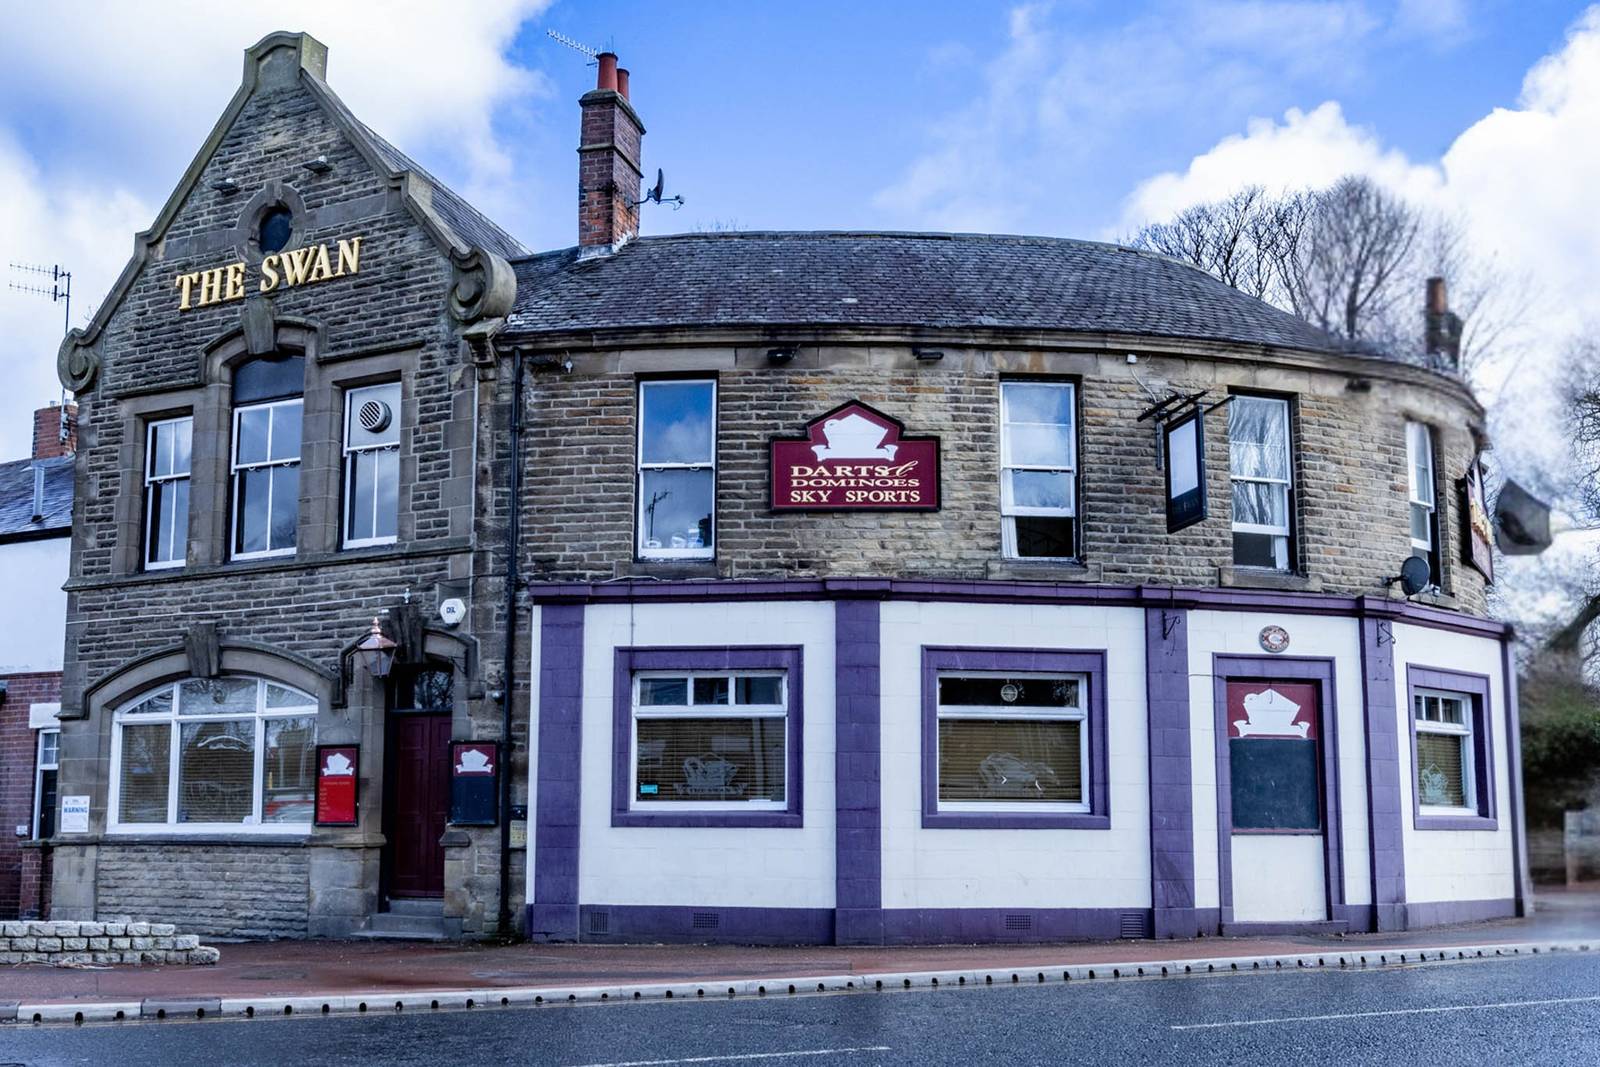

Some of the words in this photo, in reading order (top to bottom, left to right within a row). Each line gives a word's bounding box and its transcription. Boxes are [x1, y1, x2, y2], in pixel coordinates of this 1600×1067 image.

[175, 262, 246, 311] THE
[259, 236, 363, 293] SWAN
[790, 465, 888, 478] DARTS
[790, 478, 921, 488] DOMINOES
[790, 489, 832, 503] SKY
[845, 489, 921, 503] SPORTS
